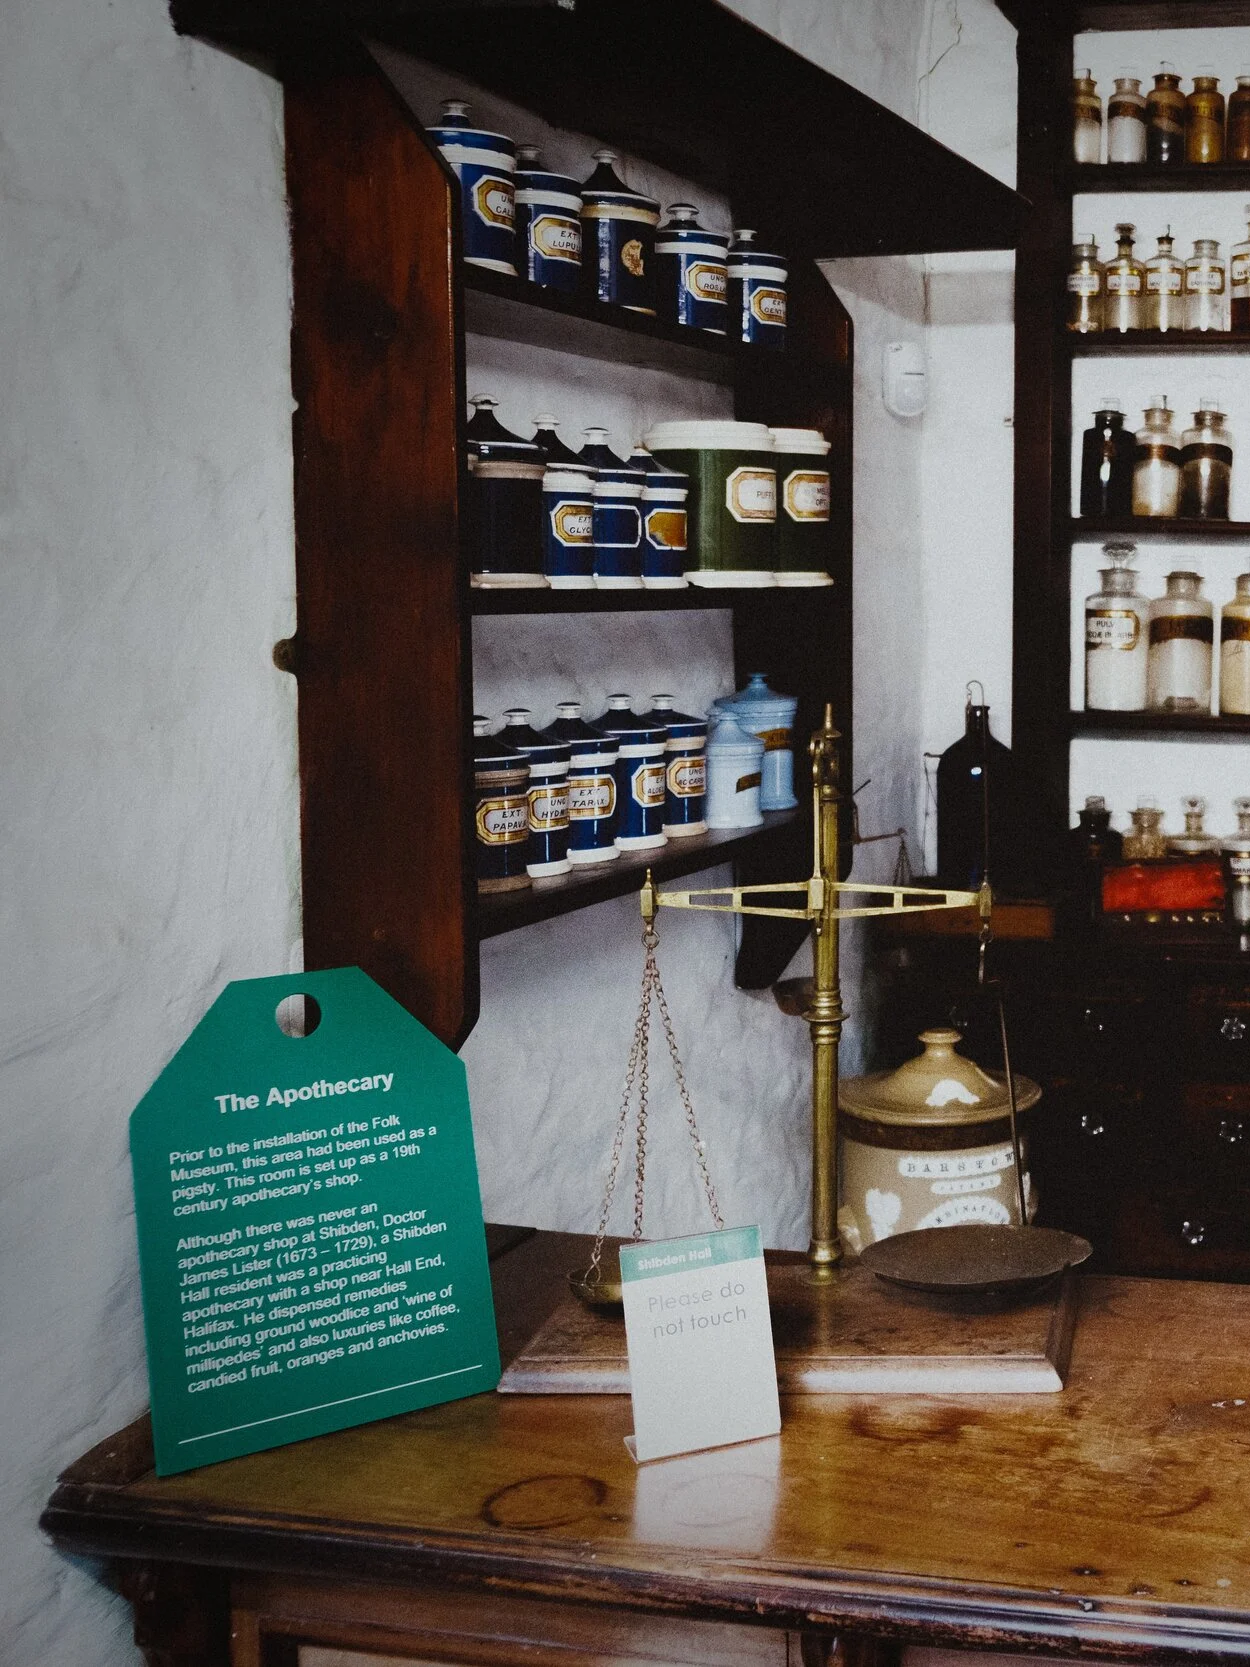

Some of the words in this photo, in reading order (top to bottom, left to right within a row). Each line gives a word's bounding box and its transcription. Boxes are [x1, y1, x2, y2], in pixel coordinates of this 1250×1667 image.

[214, 1093, 259, 1113] The
[266, 1072, 393, 1107] Apothecary
[169, 1150, 204, 1164] Prior
[208, 1146, 222, 1157] to
[226, 1142, 249, 1154] the
[253, 1129, 326, 1149] installation
[330, 1123, 343, 1136] of
[346, 1121, 368, 1133] the
[372, 1114, 400, 1128] Folk
[170, 1162, 237, 1181] Museum,
[242, 1155, 267, 1168] this
[271, 1149, 303, 1163] area
[306, 1142, 332, 1157] had
[335, 1138, 369, 1152] been
[373, 1129, 405, 1145] used
[409, 1128, 425, 1139] as
[428, 1126, 436, 1135] a
[172, 1182, 218, 1201] pigsty.
[224, 1174, 255, 1188] This
[258, 1168, 295, 1182] room
[298, 1164, 310, 1175] is
[314, 1158, 335, 1172] set
[338, 1157, 356, 1169] up
[359, 1153, 376, 1164] as
[379, 1151, 388, 1160] a
[392, 1143, 420, 1157] 19th
[173, 1198, 227, 1216] century
[325, 1173, 361, 1187] shop.
[176, 1228, 241, 1250] Although
[245, 1222, 282, 1237] there
[286, 1215, 314, 1228] was
[318, 1206, 356, 1222] never
[360, 1203, 377, 1214] an
[178, 1244, 259, 1269] apothecary
[263, 1236, 298, 1251] shop
[301, 1230, 315, 1243] at
[319, 1220, 378, 1239] Shibden,
[382, 1209, 426, 1226] Doctor
[179, 1268, 228, 1286] James
[232, 1258, 272, 1274] Lister
[276, 1246, 317, 1267] (1673
[334, 1235, 376, 1252] 1729),
[380, 1234, 389, 1244] a
[393, 1222, 446, 1241] Shibden
[181, 1286, 209, 1303] Hall
[214, 1274, 272, 1296] resident
[275, 1269, 304, 1282] was
[308, 1266, 317, 1276] a
[321, 1251, 387, 1276] practicing
[637, 1252, 687, 1271] Shibden
[688, 1248, 712, 1262] Hall
[182, 1295, 263, 1322] apothecary
[267, 1286, 296, 1302] with
[300, 1285, 309, 1295] a
[313, 1277, 347, 1292] shop
[351, 1269, 381, 1284] near
[385, 1260, 411, 1276] Hall
[415, 1253, 444, 1270] End,
[183, 1320, 238, 1338] Halifax.
[243, 1312, 264, 1325] He
[268, 1293, 340, 1319] dispensed
[344, 1281, 407, 1302] remedies
[648, 1287, 713, 1313] Please
[720, 1280, 745, 1298] do
[185, 1333, 250, 1356] including
[255, 1318, 304, 1343] ground
[308, 1306, 369, 1328] woodlice
[373, 1296, 398, 1313] and
[439, 1284, 452, 1298] of
[268, 1338, 295, 1355] and
[299, 1333, 329, 1348] also
[332, 1320, 385, 1340] luxuries
[389, 1313, 412, 1327] like
[415, 1303, 459, 1320] coffee,
[653, 1318, 684, 1338] not
[690, 1306, 746, 1330] touch
[188, 1368, 246, 1392] candied
[251, 1361, 281, 1377] fruit,
[286, 1347, 344, 1368] oranges
[348, 1337, 373, 1354] and
[377, 1323, 448, 1347] anchovies.
